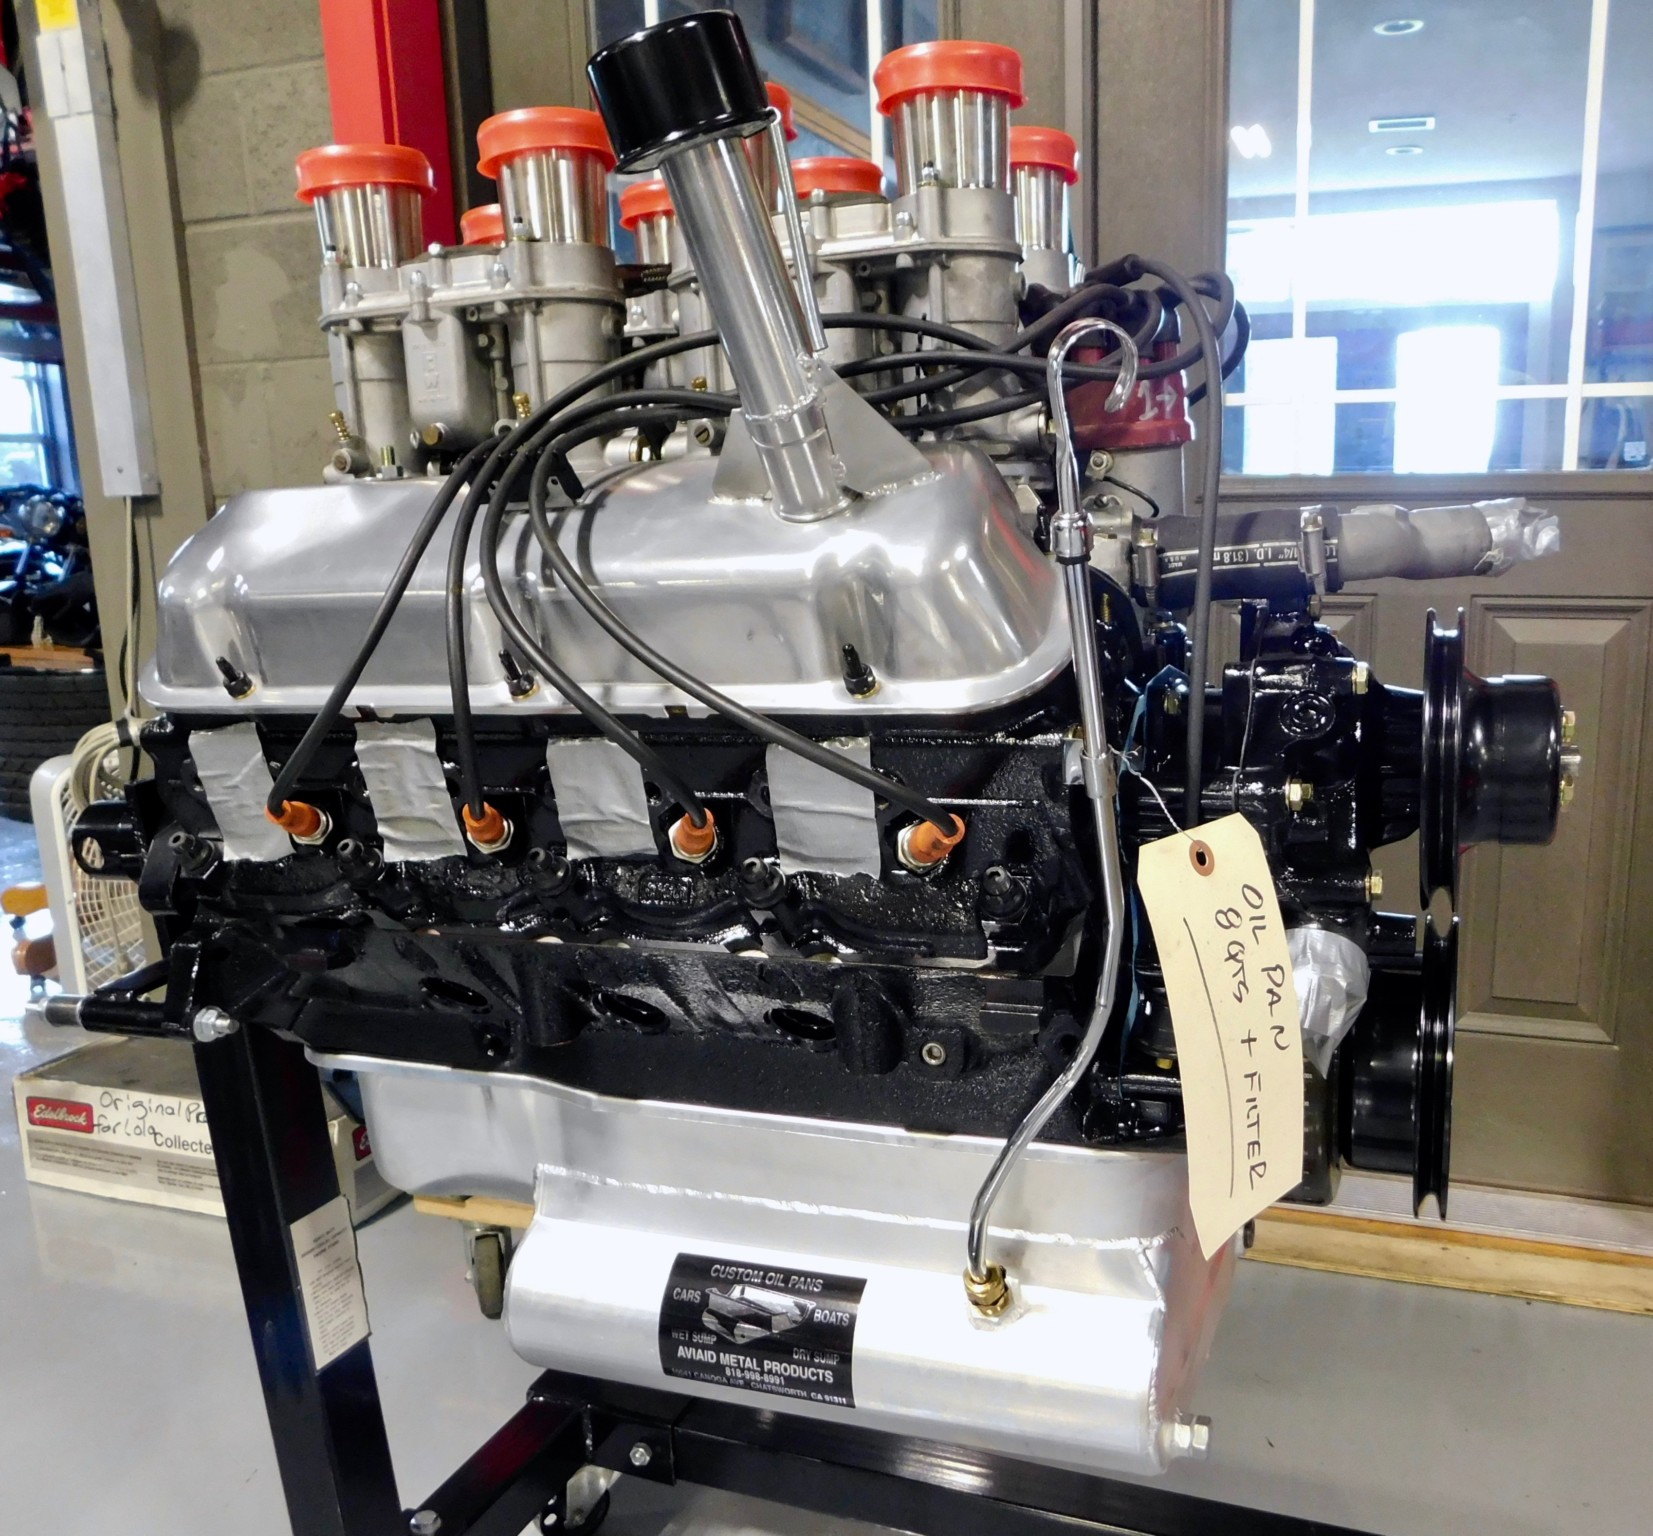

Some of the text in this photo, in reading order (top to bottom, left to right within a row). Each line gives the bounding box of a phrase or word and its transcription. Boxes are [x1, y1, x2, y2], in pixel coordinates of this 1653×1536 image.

[1214, 907, 1243, 930] 8
[1241, 883, 1290, 1051] OIL PAN
[1240, 1028, 1258, 1058] +
[33, 1104, 88, 1126] Edelbrock
[100, 1091, 181, 1120] Original
[94, 1114, 121, 1135] for
[1243, 1071, 1268, 1191] FILTER
[710, 1264, 824, 1293] CUSTOM OIL PANS
[673, 1287, 702, 1303] CARS
[813, 1308, 850, 1327] BOATS
[671, 1328, 717, 1345] WET SUMP
[677, 1345, 834, 1384] AVIAID METAL PRODUCTS
[792, 1347, 840, 1366] DRY SUMP
[725, 1366, 785, 1386] 818-998-8991
[810, 1392, 823, 1401] CA
